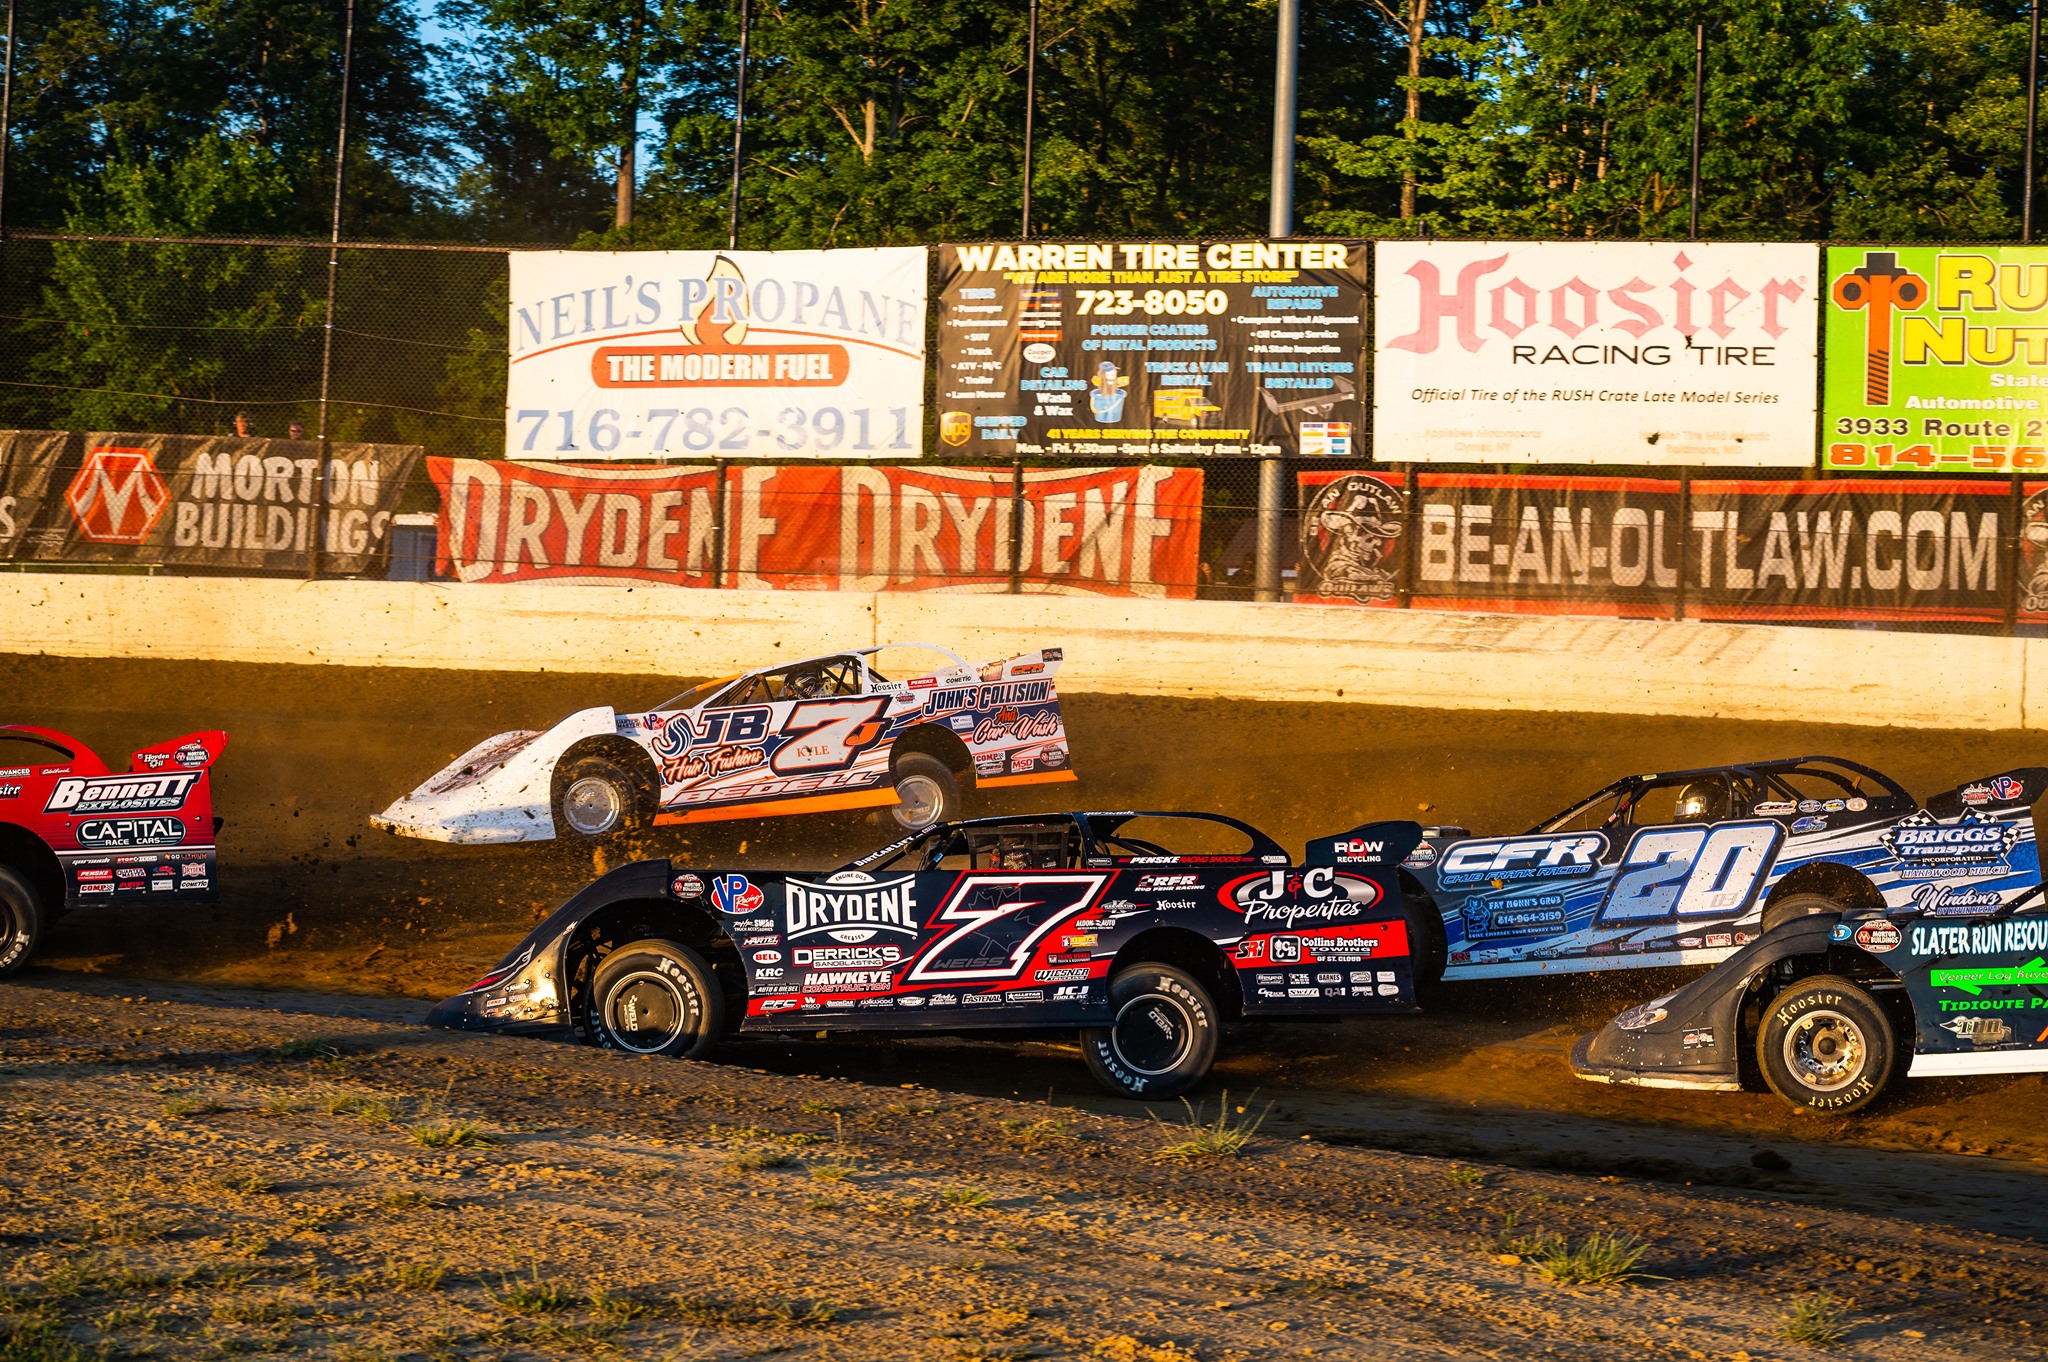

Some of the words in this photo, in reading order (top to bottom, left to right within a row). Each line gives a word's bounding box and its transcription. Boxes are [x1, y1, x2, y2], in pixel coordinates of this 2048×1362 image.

[956, 244, 1113, 271] WARREN
[1119, 244, 1199, 270] TIRE
[1206, 243, 1349, 269] CENTER
[1037, 271, 1067, 284] ARE
[1068, 271, 1111, 284] MORE
[1112, 271, 1154, 284] THAN
[1155, 271, 1192, 284] JUST
[1193, 271, 1206, 284] A
[1207, 271, 1241, 284] TIRE
[1251, 286, 1339, 298] AUTOMOTIVE
[1076, 289, 1228, 315] 723-8050
[1266, 299, 1323, 310] REPAIRS
[1385, 250, 1806, 354] Hoosier
[517, 275, 660, 351] NEIL'S
[678, 277, 918, 348] PROPANE
[1090, 325, 1148, 336] POWDER
[1149, 325, 1208, 336] COATING
[1271, 330, 1304, 340] Change
[1305, 330, 1339, 339] Service
[1082, 340, 1101, 351] OF
[1102, 340, 1146, 351] METAL
[1147, 340, 1217, 351] PRODUCTS
[1268, 345, 1292, 353] State
[1513, 345, 1670, 366] RACING
[1690, 346, 1776, 366] TIRE
[607, 355, 655, 382] THE
[660, 355, 769, 381] MODERN
[775, 354, 833, 381] FUEL
[1040, 367, 1068, 378] CAR
[1144, 362, 1187, 373] TRUCK
[1199, 362, 1229, 373] VAN
[1246, 362, 1298, 373] TRAILER
[1299, 362, 1354, 373] HITCHES
[1020, 380, 1088, 391] DETAILING
[1161, 375, 1212, 386] RENTAL
[1265, 378, 1334, 389] INSTALLED
[1036, 393, 1072, 404] Wash
[1410, 388, 1467, 403] Official
[1470, 389, 1499, 402] Tire
[1503, 388, 1521, 404] of
[1523, 389, 1548, 402] the
[1552, 389, 1594, 402] RUSH
[1599, 389, 1639, 402] Crate
[1644, 390, 1676, 403] Late
[1681, 390, 1730, 404] Model
[1733, 391, 1780, 405] Series
[1905, 396, 2040, 410] Automotive
[1046, 406, 1074, 416] Wax
[974, 416, 1028, 427] SHIPPED
[1838, 418, 1909, 435] 3933
[1925, 419, 2011, 436] Route
[517, 407, 913, 452] 716-782-3911
[981, 429, 1020, 440] DAILY
[1160, 443, 1214, 456] Saturday
[191, 453, 380, 506] MORTON
[174, 501, 391, 556] BUILDINGS
[910, 678, 935, 686] PENSKE
[945, 675, 972, 684] COMETIC
[870, 683, 902, 693] Hoosier
[925, 687, 976, 715] JOHN'S
[979, 681, 1049, 708] COLLISION
[692, 710, 769, 746] JB
[1011, 713, 1058, 738] Wash
[797, 745, 830, 757] KYLE
[666, 757, 703, 783] Hair
[706, 749, 763, 775] Fashions
[1012, 759, 1033, 768] MSD
[75, 797, 182, 812] EXPLOSIVES
[82, 820, 182, 840] CAPITAL
[1895, 827, 2002, 845] BRIGGS
[105, 838, 130, 846] RACE
[136, 837, 161, 845] CARS
[1334, 841, 1384, 853] RDW
[1901, 843, 2002, 855] Transport
[1130, 856, 1180, 864] PENSKE
[1337, 855, 1381, 863] RECYCLING
[1444, 837, 1601, 874] CFR
[835, 873, 853, 881] ENGINE
[854, 873, 867, 881] OILS
[1444, 872, 1485, 884] CHUB
[1486, 869, 1538, 880] FRANK
[1538, 864, 1592, 876] RACING
[1601, 825, 1778, 922] 20
[1902, 868, 1967, 878] HARDWOOD
[1968, 866, 2008, 876] MULCH
[1153, 875, 1197, 887] RFR
[712, 874, 749, 913] VP
[1912, 884, 2001, 910] Windows
[786, 877, 918, 935] DRYDENE
[1156, 898, 1197, 911] Hoosier
[1238, 896, 1361, 929] Properties
[907, 874, 1107, 981] 7
[839, 933, 865, 942] GREASES
[1302, 937, 1336, 947] Collins
[1336, 937, 1379, 947] Brothers
[1911, 926, 1970, 956] SLATER
[1972, 924, 2002, 954] RUN
[756, 953, 779, 961] BELL
[794, 947, 901, 966] DERRICK'S
[814, 959, 882, 967] SANDBLASTING
[932, 956, 1004, 970] WEISS
[755, 968, 784, 977] KRC
[804, 971, 892, 986] HAWKEYE
[1035, 968, 1090, 980] WIESNER
[1939, 971, 1984, 982] Veneer
[1988, 971, 2012, 983] Log
[655, 957, 700, 1017] Hoosier
[802, 983, 892, 994] CONSTRUCTION
[761, 1000, 798, 1009] PFC
[963, 995, 1001, 1004] FASTENAL
[1155, 976, 1208, 1028] Hoosier
[1939, 999, 2025, 1011] TIDIOUTE
[1776, 991, 1842, 1028] Hoosier
[1098, 1041, 1149, 1092] Hoosier
[1809, 1076, 1873, 1111] Hoosier
